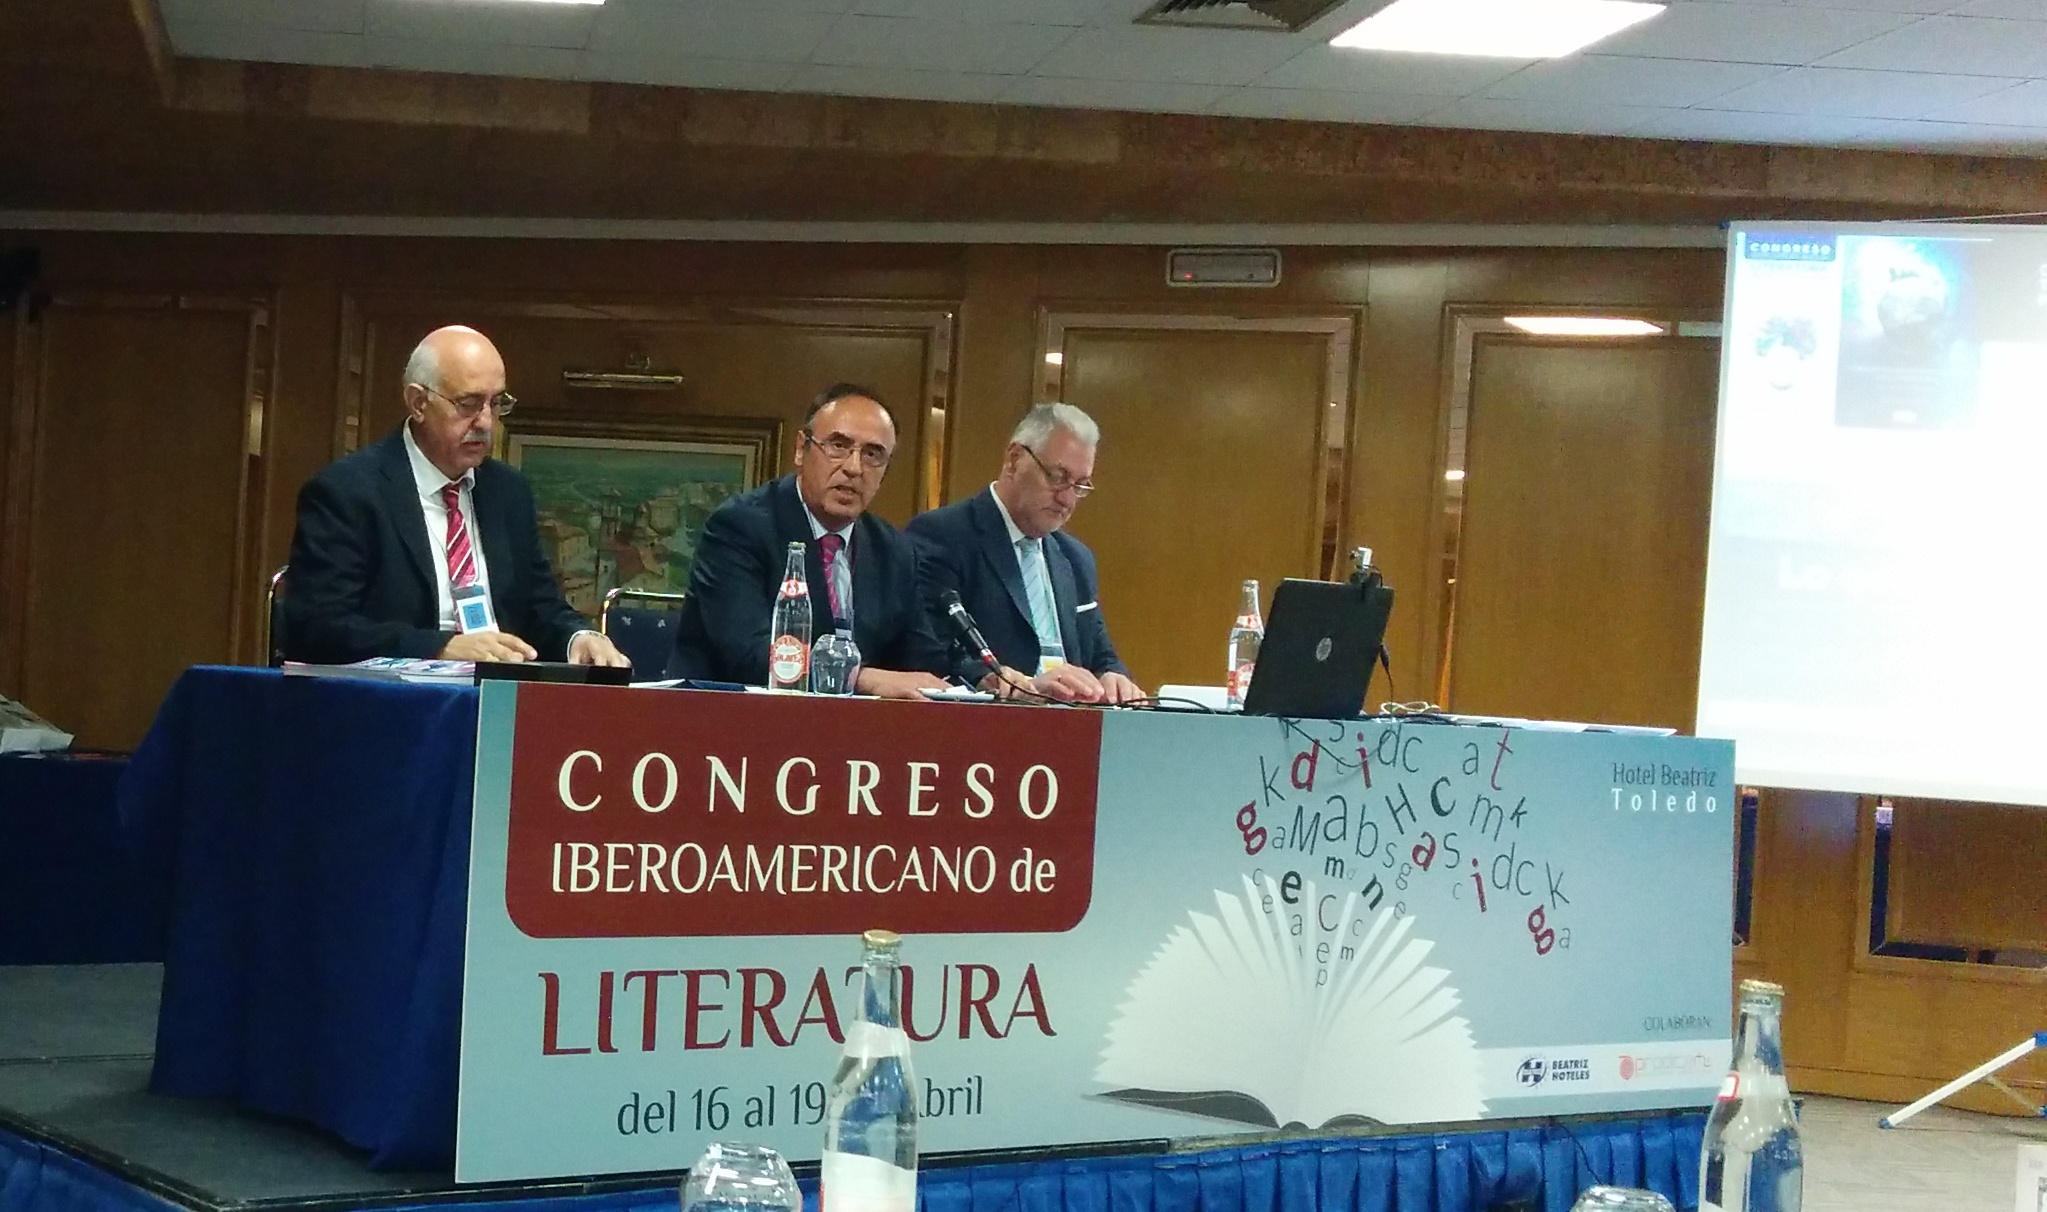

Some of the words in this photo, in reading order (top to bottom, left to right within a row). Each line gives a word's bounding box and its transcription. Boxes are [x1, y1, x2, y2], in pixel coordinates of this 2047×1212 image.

[558, 750, 1059, 820] CONGRESO
[1612, 763, 1656, 786] Hotel
[1661, 764, 1716, 787] Beatriz
[1611, 788, 1717, 813] Toledo
[551, 842, 996, 895] IBEROAMERICANO
[1009, 847, 1057, 893] de
[1643, 1015, 1711, 1031] COLABORAN
[1552, 1059, 1589, 1070] BEATRIZ
[1552, 1070, 1590, 1081] HOTELES
[617, 1090, 677, 1136] del
[692, 1086, 730, 1131] 16
[744, 1085, 775, 1128] al
[790, 1081, 826, 1125] 19
[919, 1075, 983, 1118] bril
